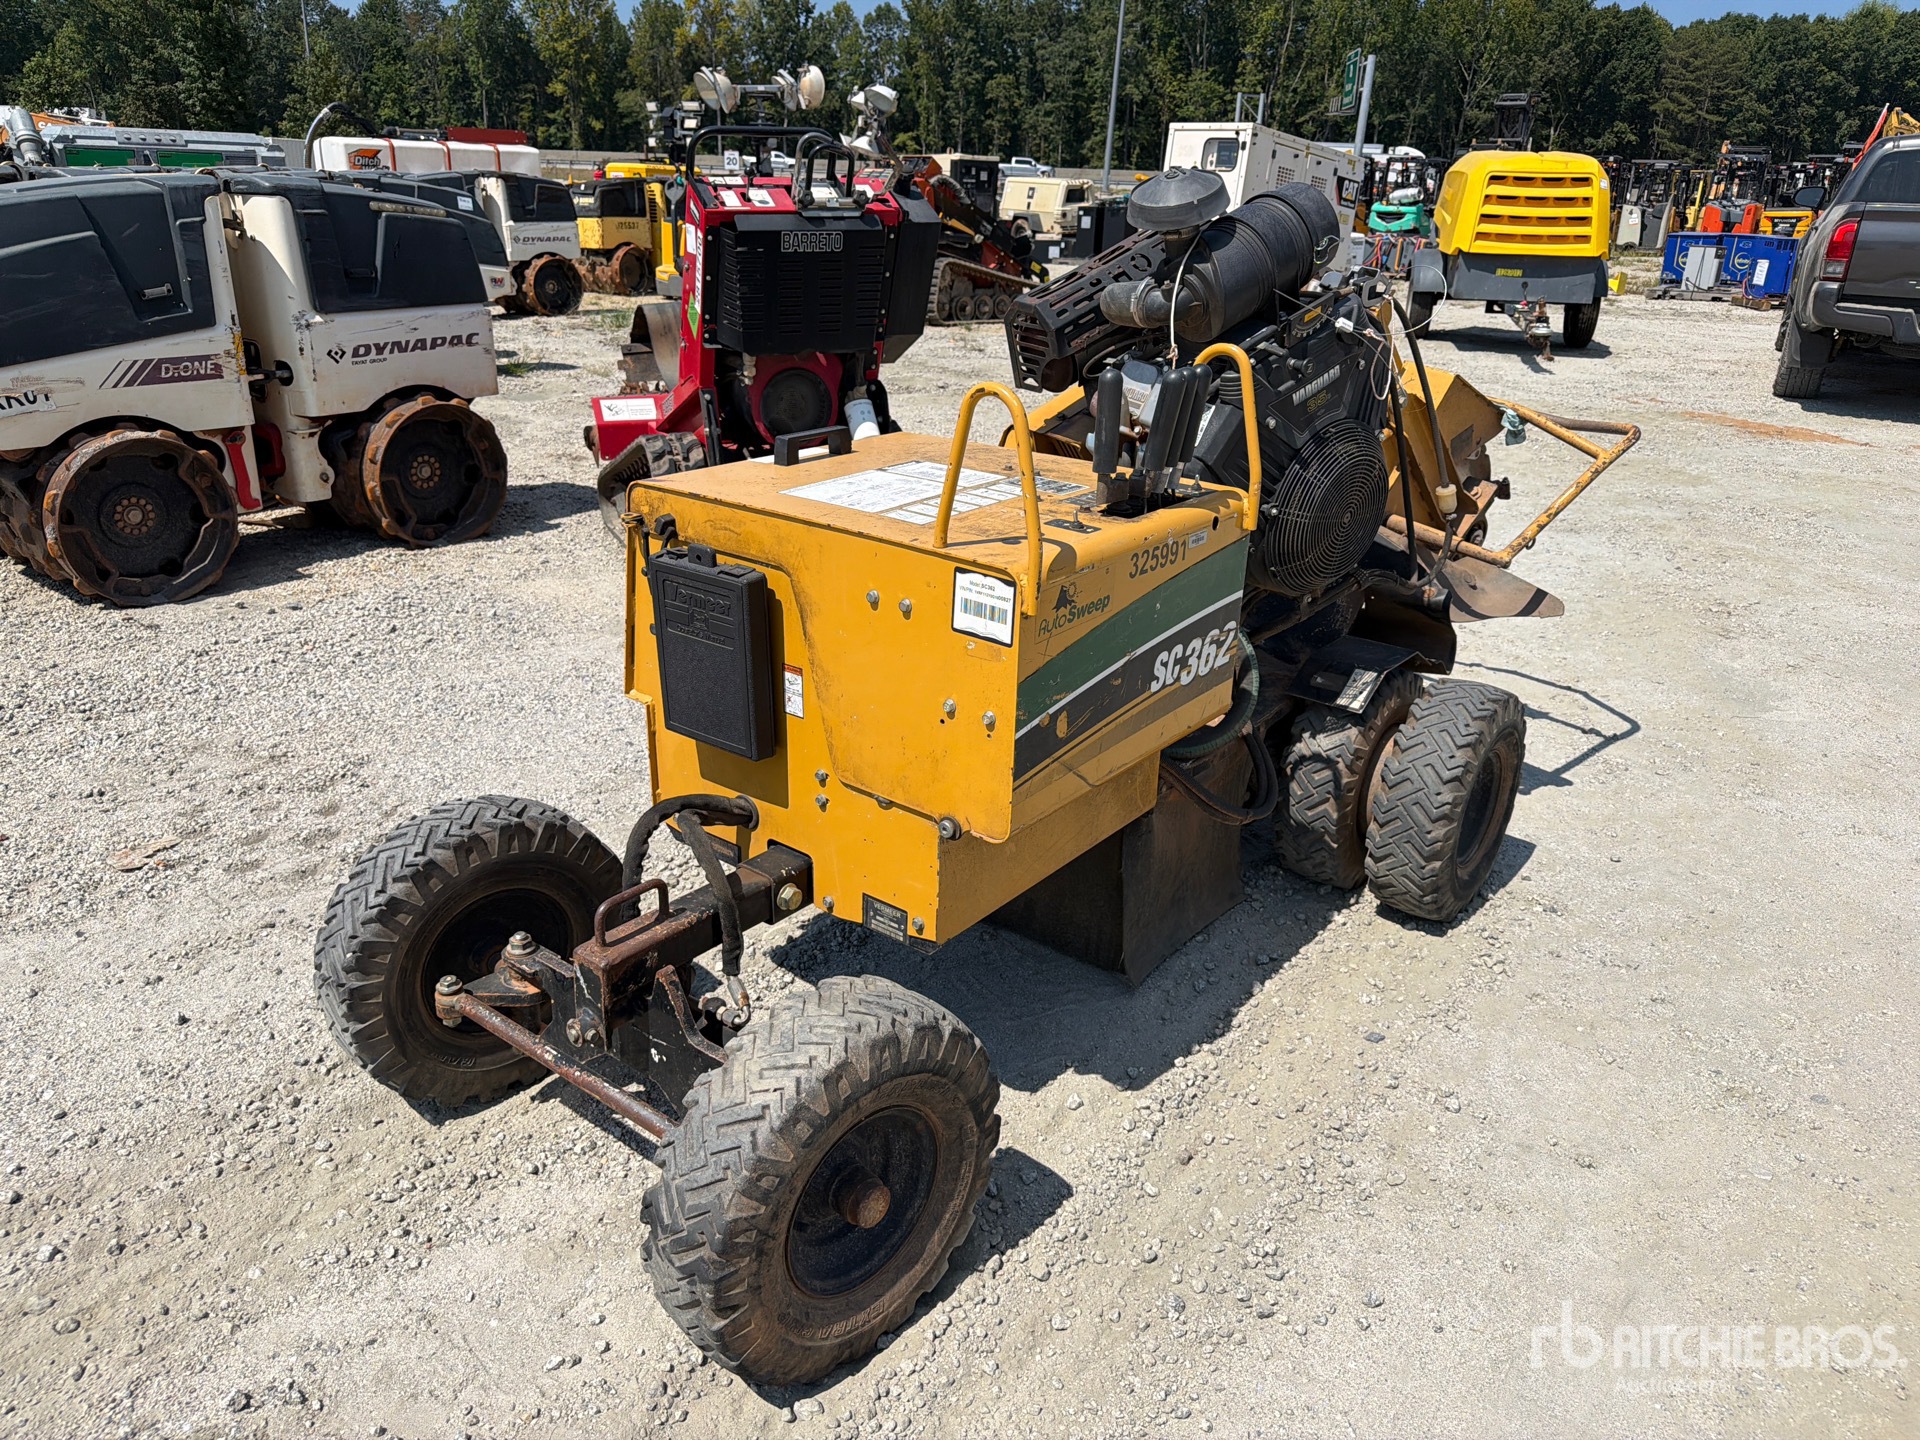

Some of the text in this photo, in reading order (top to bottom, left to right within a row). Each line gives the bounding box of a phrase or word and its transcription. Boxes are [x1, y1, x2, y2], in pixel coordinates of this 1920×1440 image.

[354, 155, 380, 167] Ditch
[725, 156, 738, 166] 20
[1341, 179, 1359, 201] CAT
[780, 231, 844, 253] BARRETO
[351, 332, 480, 359] DYNAPAC
[1292, 364, 1340, 407] VANGUARD
[1128, 539, 1187, 580] 325991
[1038, 594, 1111, 638] AutoSweep
[873, 901, 902, 919] VERMEER
